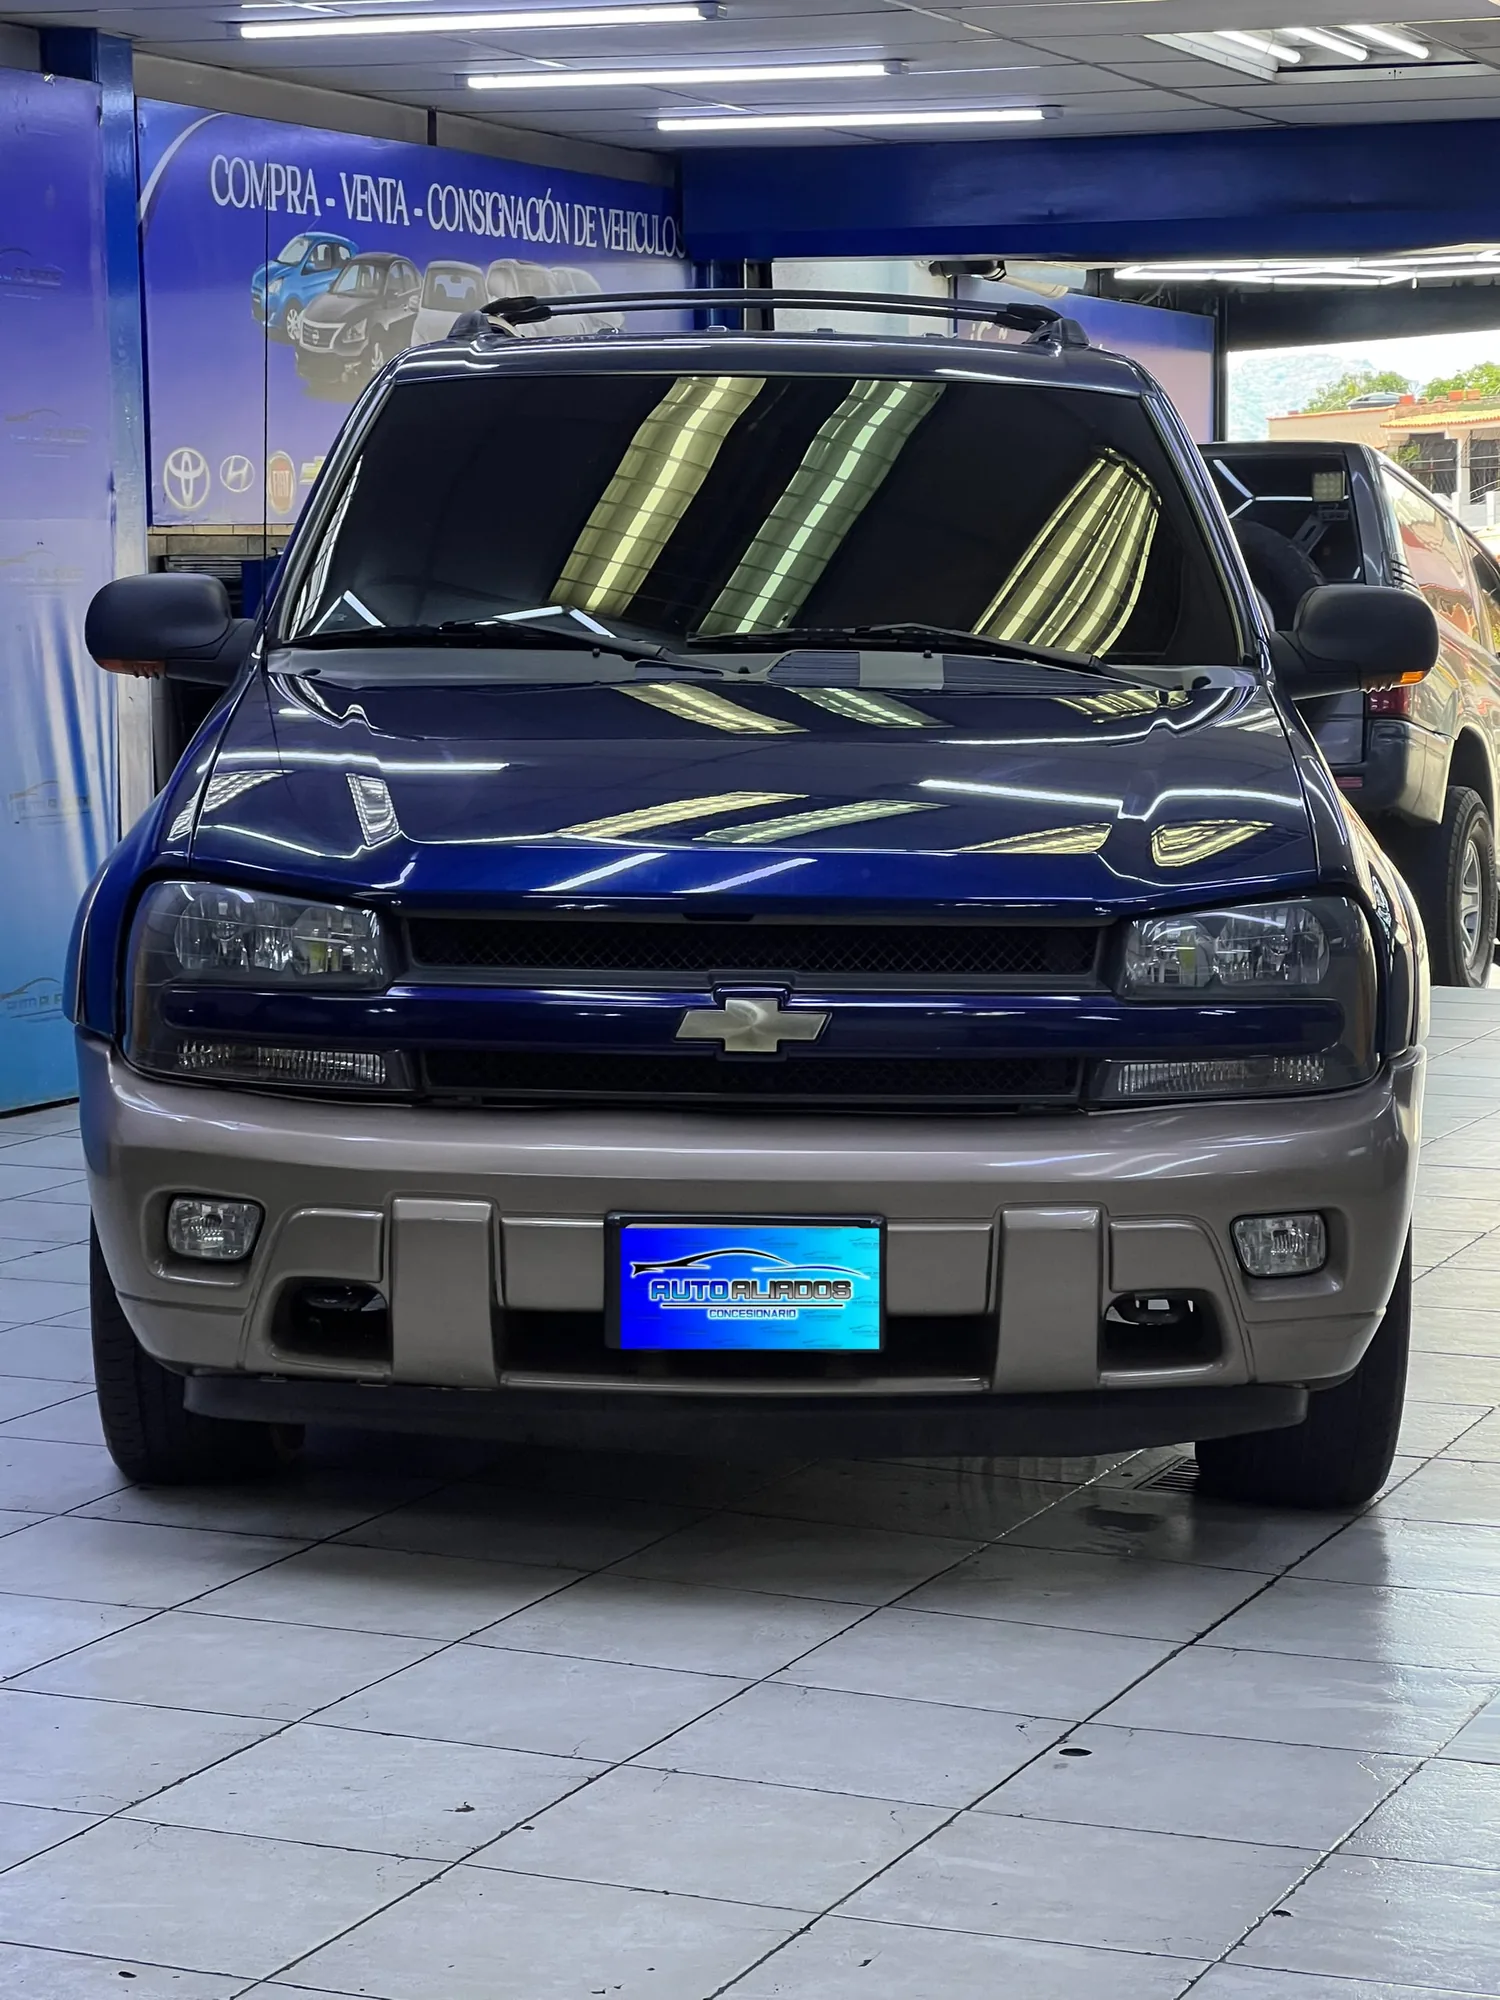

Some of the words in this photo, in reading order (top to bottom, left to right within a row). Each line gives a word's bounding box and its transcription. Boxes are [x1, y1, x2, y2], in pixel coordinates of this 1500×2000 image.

[210, 154, 321, 216] COMPRA
[339, 171, 410, 226] VENTA
[427, 182, 570, 245] CONSIGNACIÓN
[574, 203, 598, 248] DE
